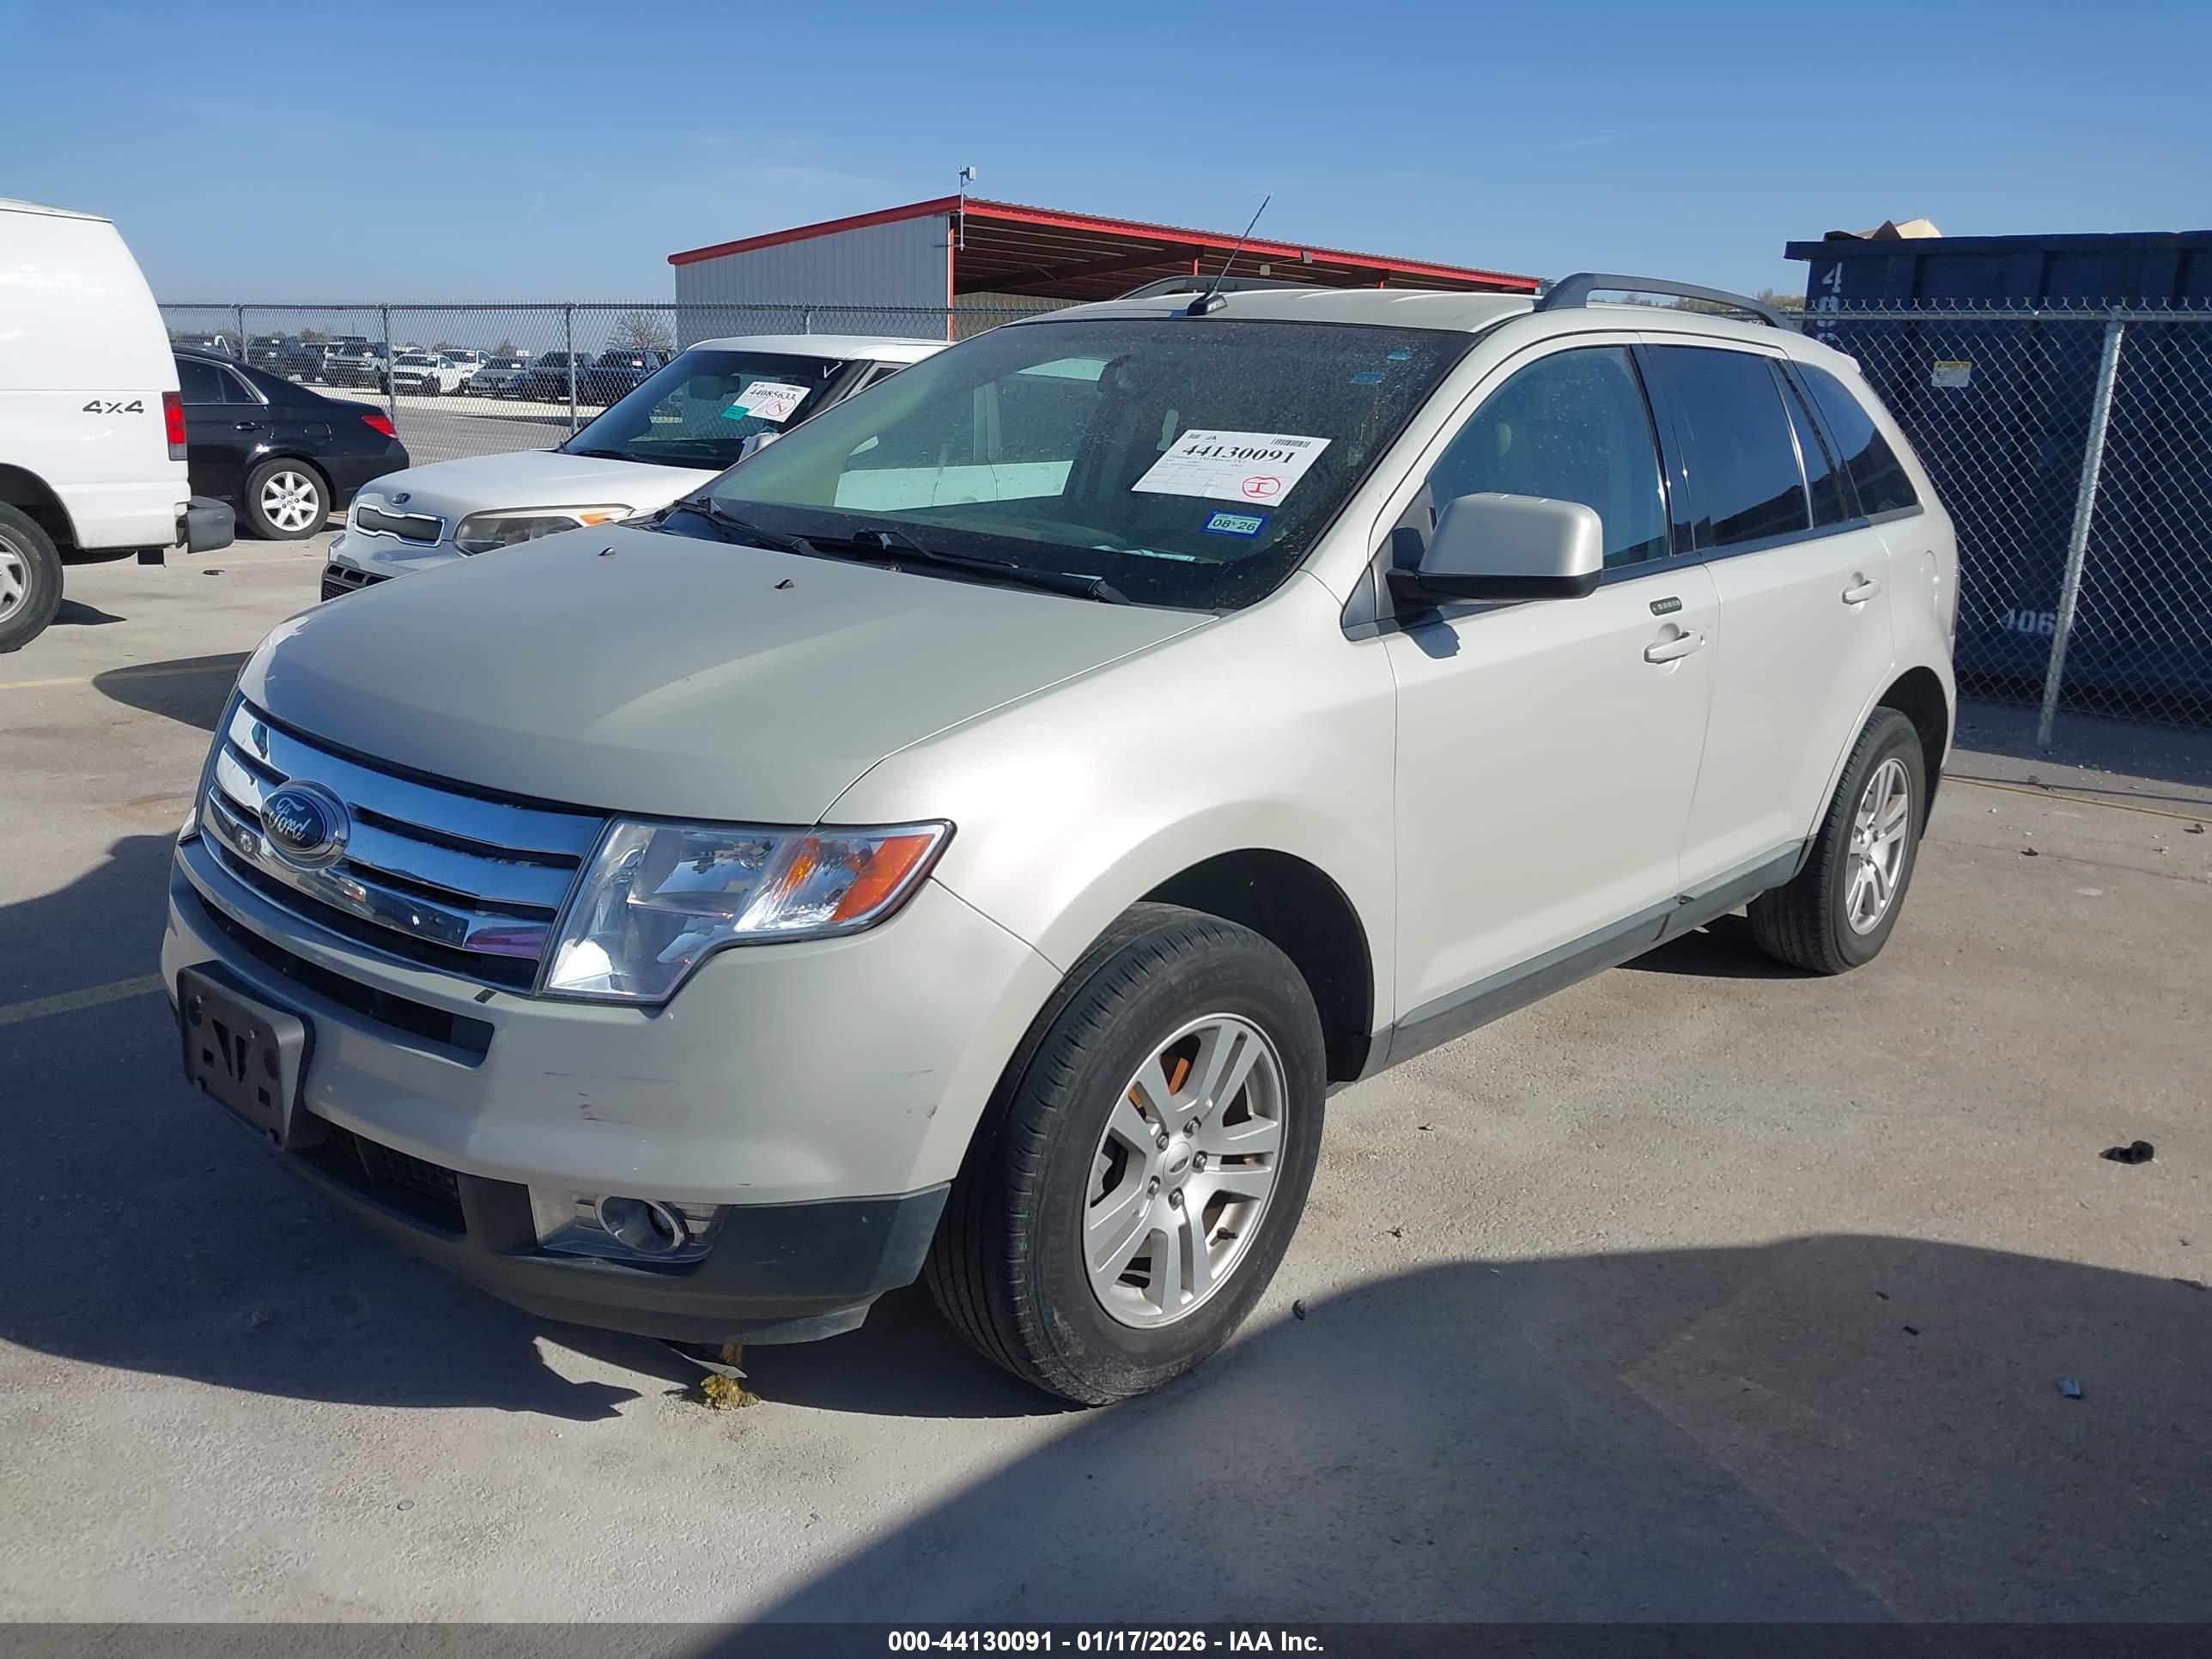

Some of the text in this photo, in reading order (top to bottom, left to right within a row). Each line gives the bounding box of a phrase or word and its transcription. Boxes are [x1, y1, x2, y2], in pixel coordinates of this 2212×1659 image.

[1182, 444, 1296, 464] 44130091
[1212, 519, 1231, 528] 08
[1237, 521, 1257, 532] 26
[2001, 609, 2075, 637] 406
[268, 797, 313, 842] Ford
